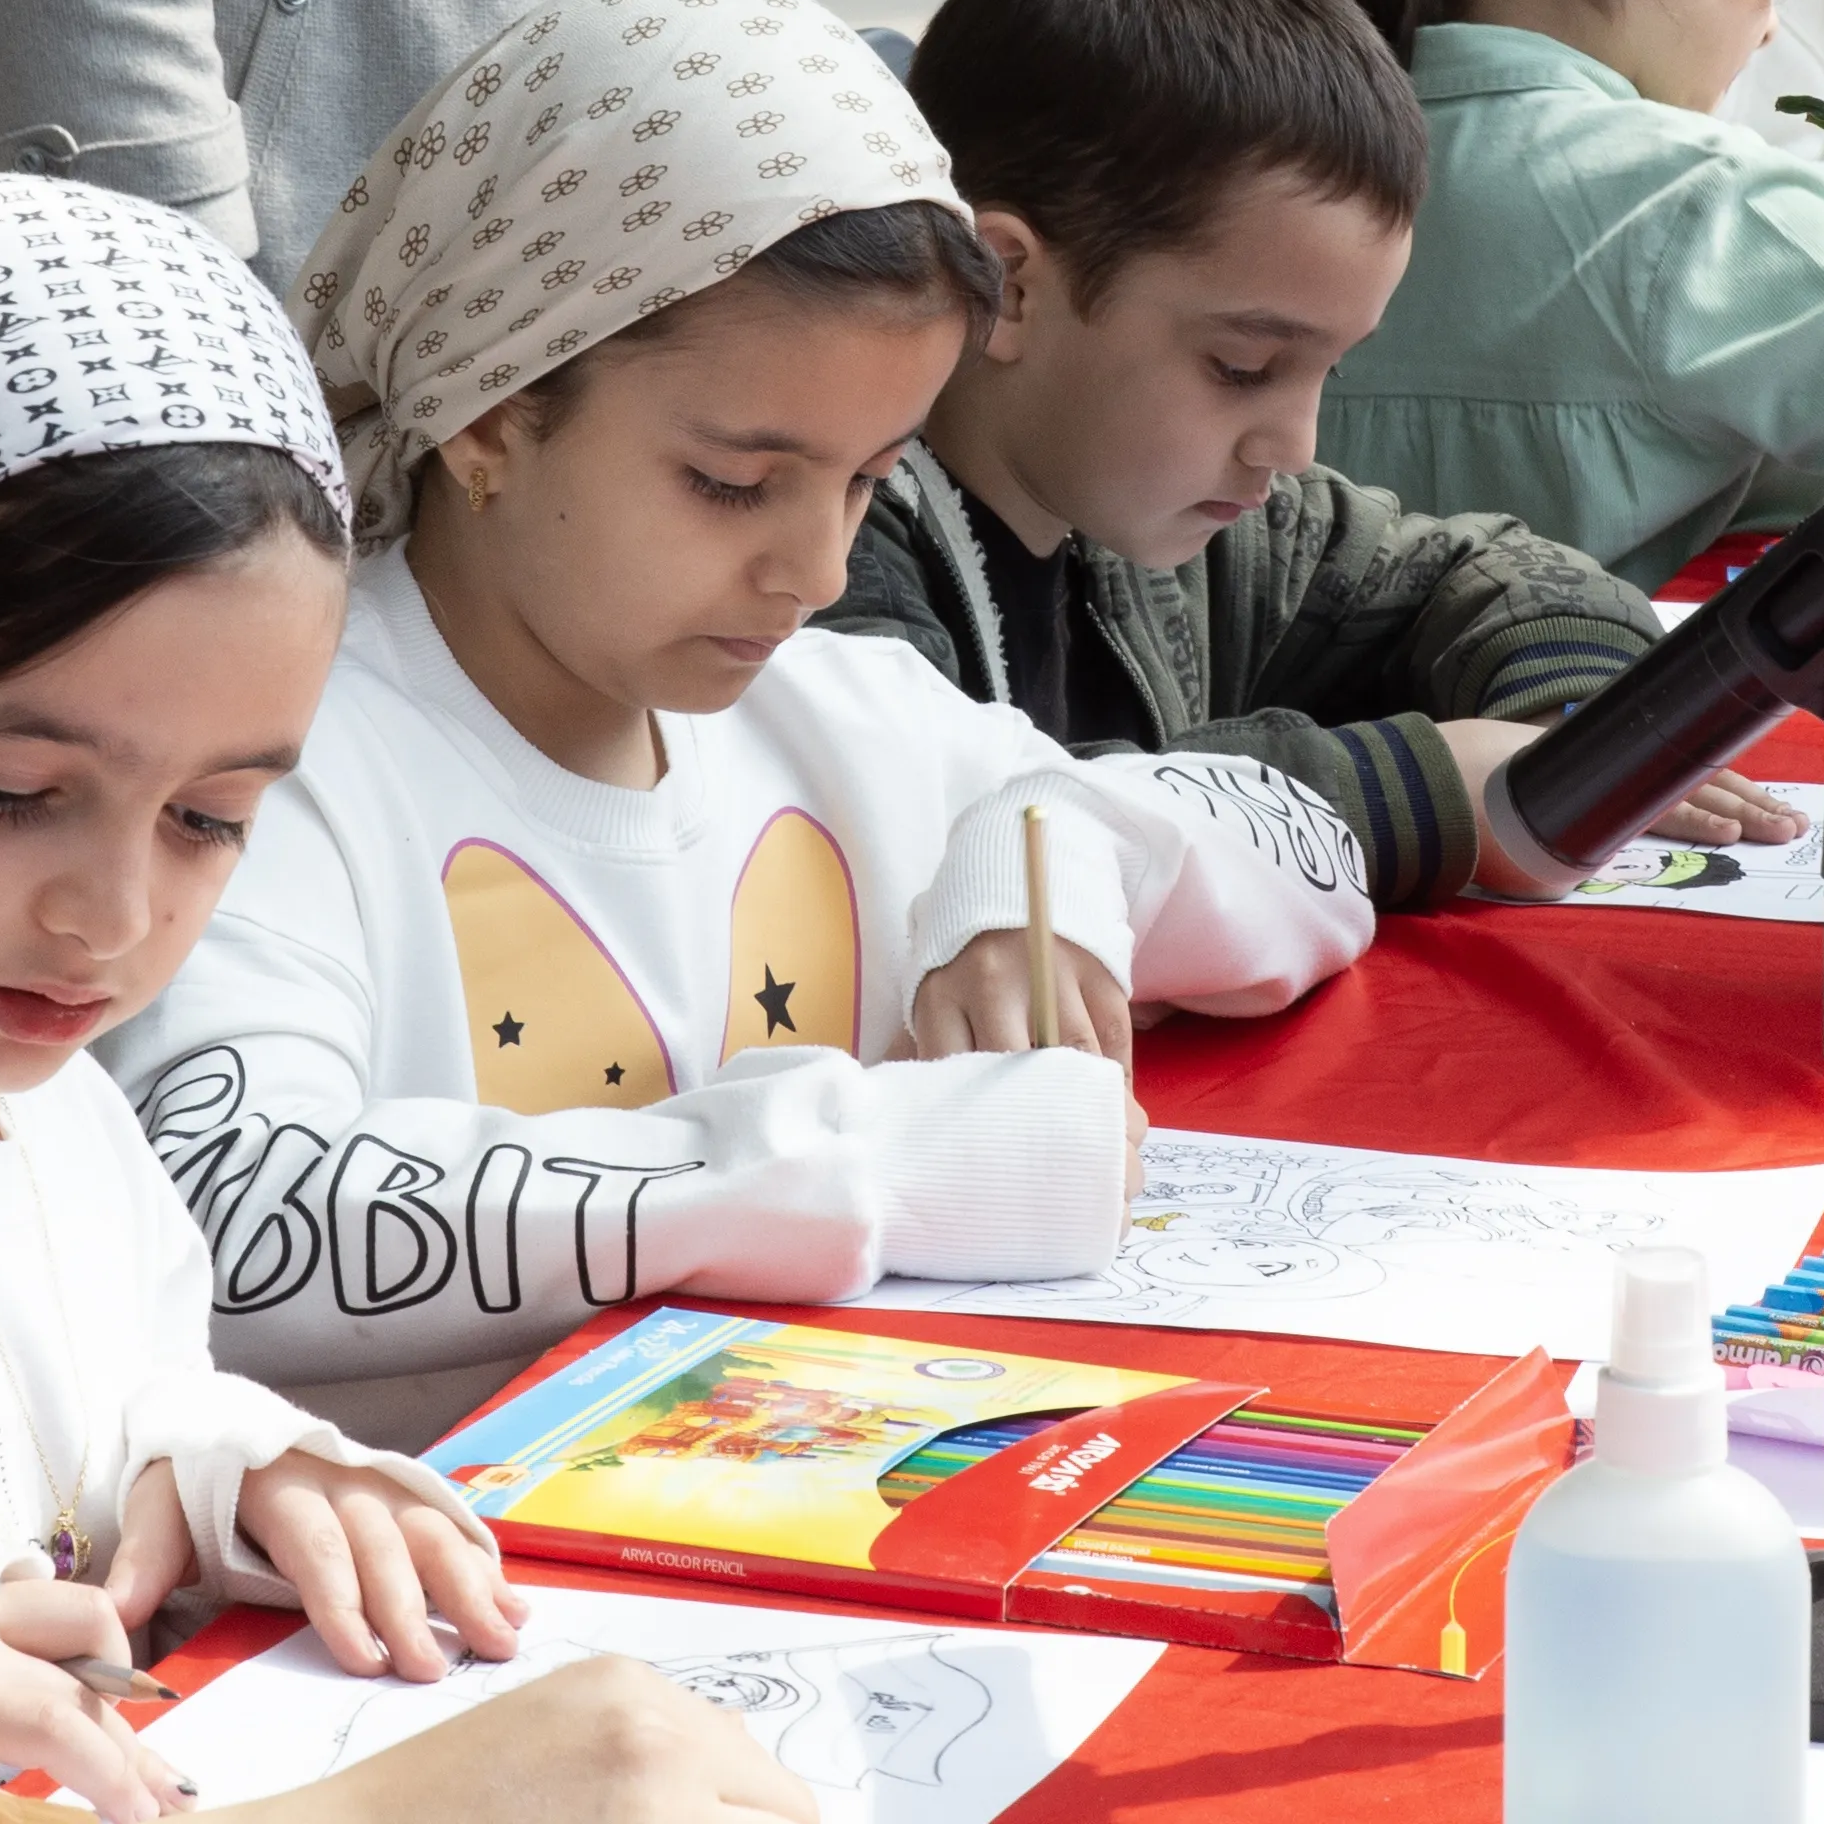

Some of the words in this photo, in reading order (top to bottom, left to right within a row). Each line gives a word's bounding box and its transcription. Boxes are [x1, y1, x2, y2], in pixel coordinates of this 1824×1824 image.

[1036, 1443, 1069, 1462] Since
[1043, 1433, 1121, 1484] ARYA
[621, 1546, 654, 1564] ARYA
[656, 1552, 701, 1571] COLOR
[703, 1558, 747, 1577] PENCIL
